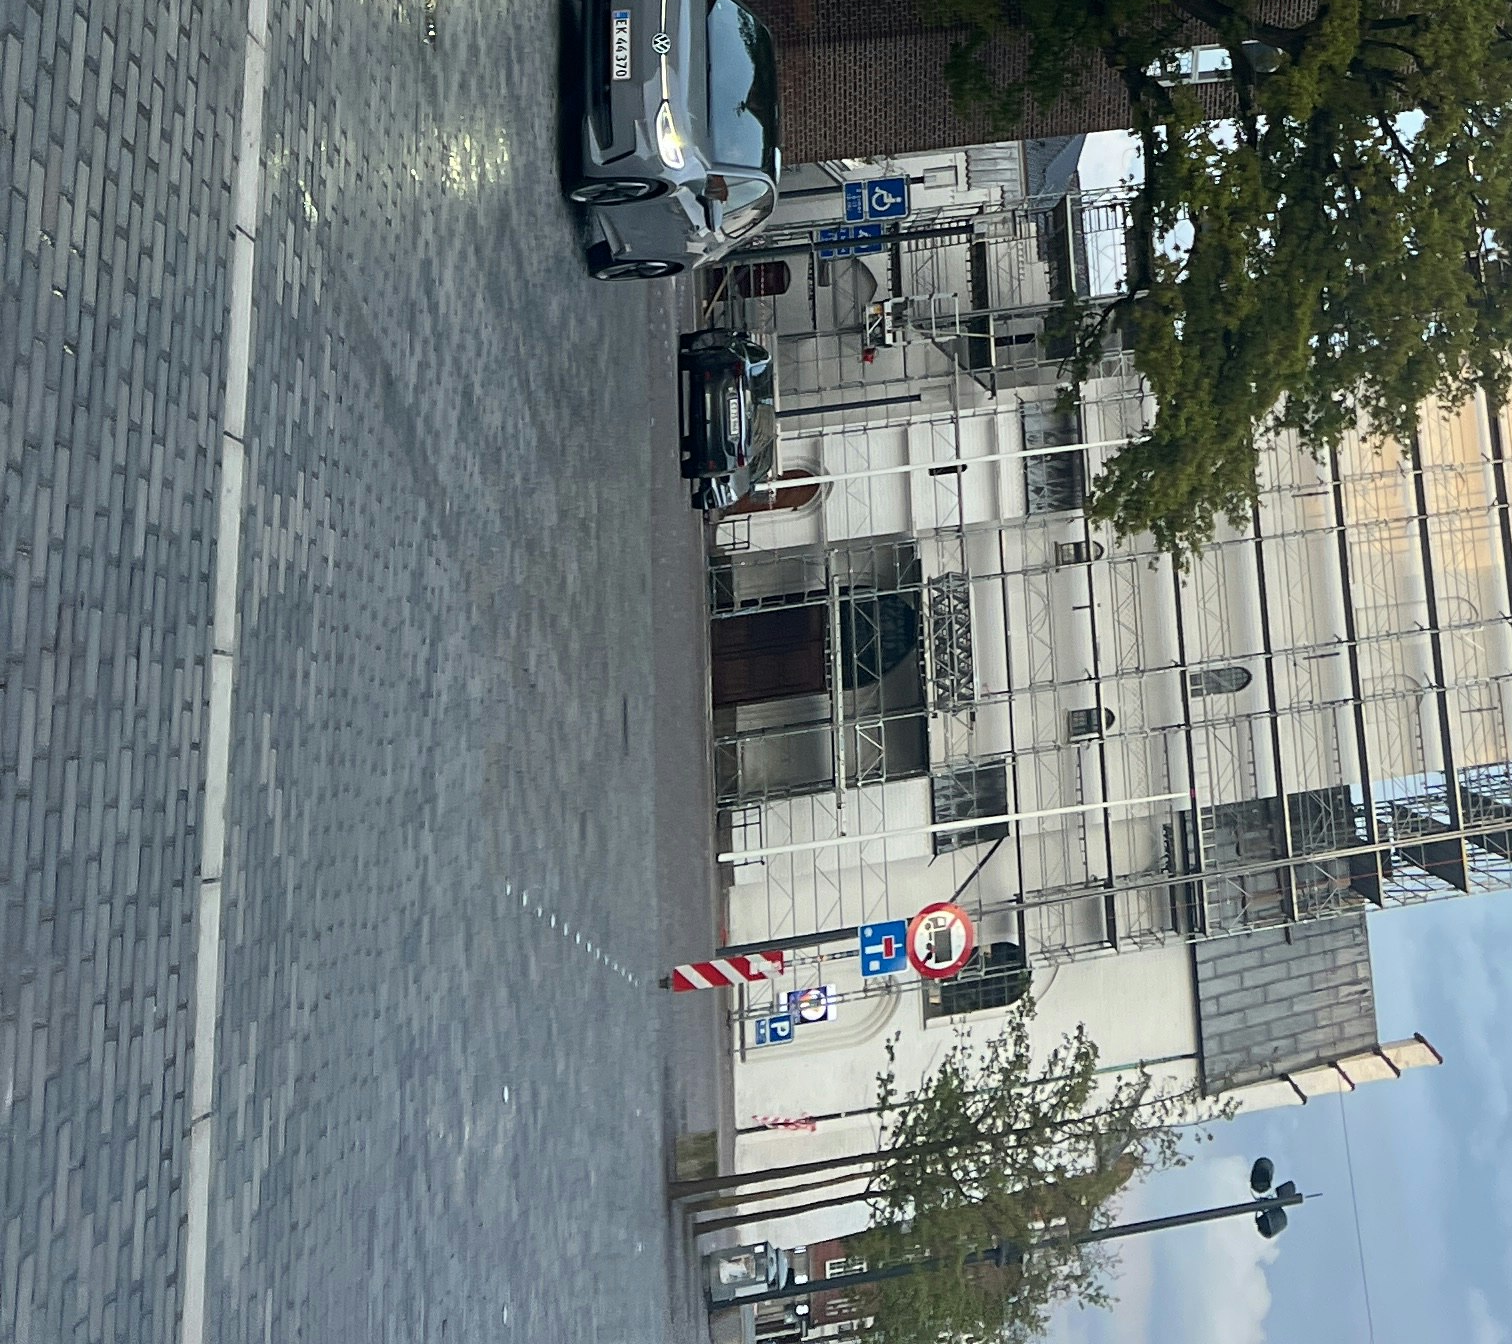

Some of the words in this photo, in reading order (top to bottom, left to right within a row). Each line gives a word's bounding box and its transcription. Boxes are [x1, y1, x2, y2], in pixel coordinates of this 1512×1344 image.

[615, 19, 627, 34] EK
[615, 37, 628, 52] 44
[615, 55, 627, 77] 370
[770, 1021, 790, 1037] P
